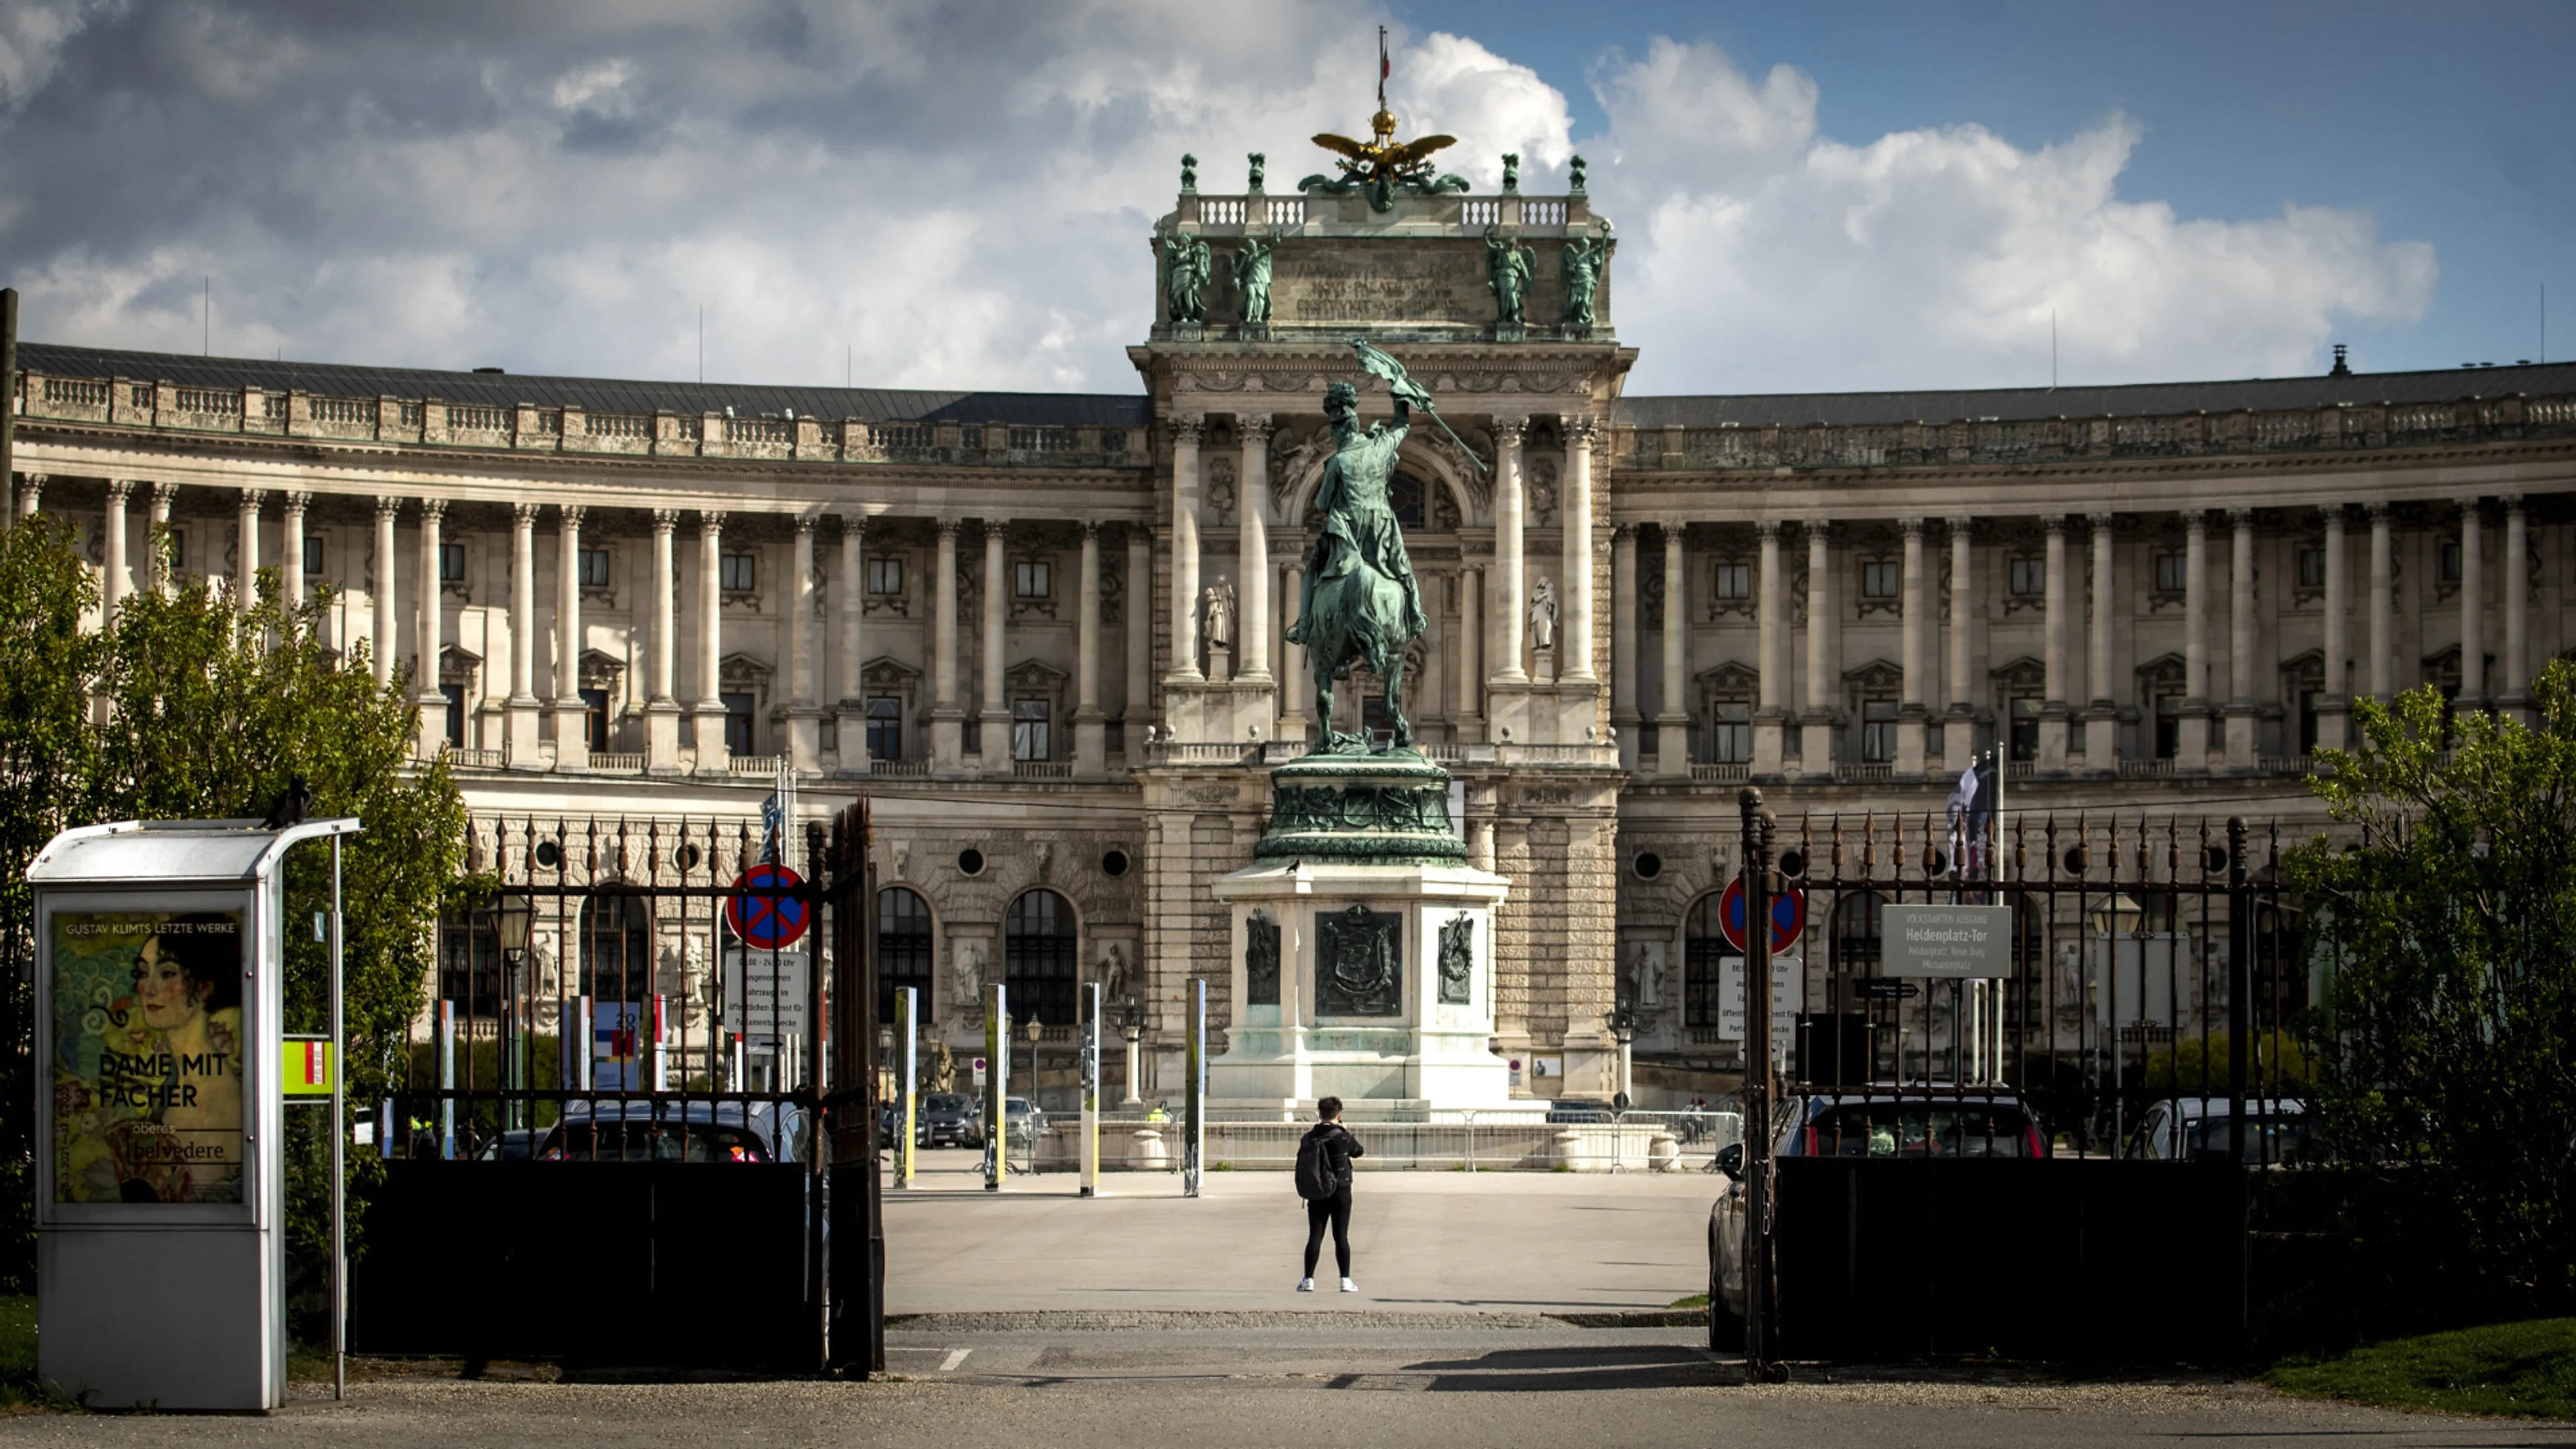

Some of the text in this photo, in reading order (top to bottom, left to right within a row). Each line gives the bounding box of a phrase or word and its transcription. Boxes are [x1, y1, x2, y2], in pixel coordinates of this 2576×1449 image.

[1906, 913, 1989, 925] VOLKSGARTEN AUSGANG
[66, 922, 235, 935] GUSTAV KLIMTS LETZTE WERKE
[1905, 928, 1988, 944] Heldenplatz-Tor
[1969, 947, 1986, 959] Burg
[783, 958, 796, 967] Uhr
[1776, 965, 1788, 973] Uhr
[747, 988, 789, 998] ahrzeug im
[794, 1004, 804, 1012] für
[100, 1053, 227, 1076] DAME MIT
[100, 1077, 197, 1108] FÄCHER
[133, 1122, 175, 1134] oberes
[134, 1140, 224, 1159] belvedere
